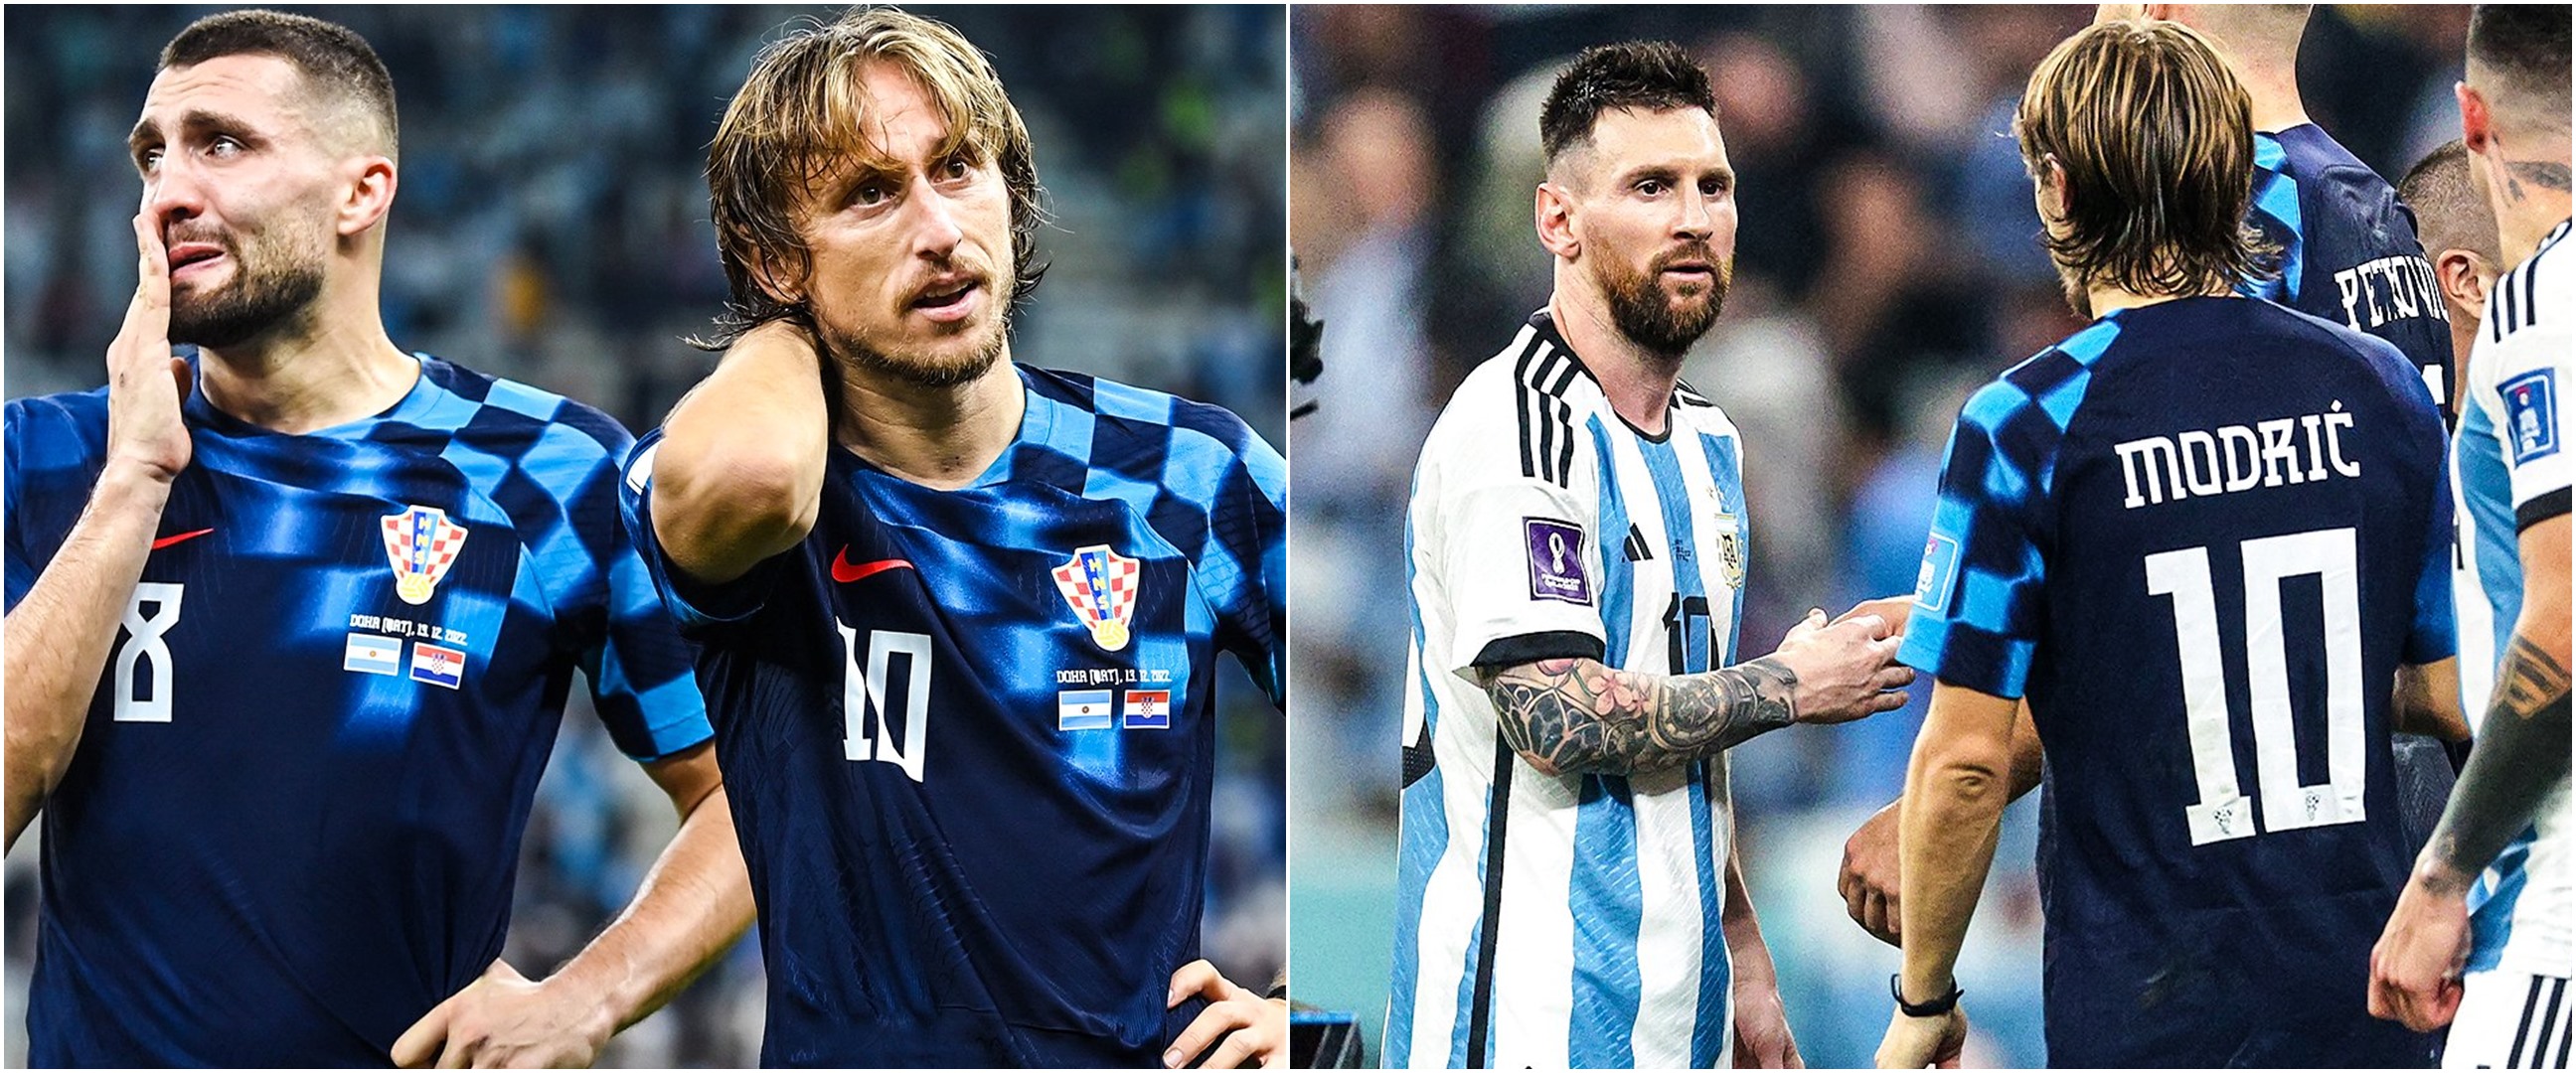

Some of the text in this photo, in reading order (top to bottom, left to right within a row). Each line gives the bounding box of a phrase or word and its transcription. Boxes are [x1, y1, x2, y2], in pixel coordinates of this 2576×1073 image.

[2114, 399, 2360, 509] MODRIĆ
[349, 614, 380, 630] DOHA
[1087, 557, 1110, 610] HNS
[113, 582, 184, 722] 8
[1056, 670, 1088, 684] DOHA
[1662, 591, 1720, 677] 10
[836, 615, 932, 783] 10
[2145, 528, 2366, 846] 10
